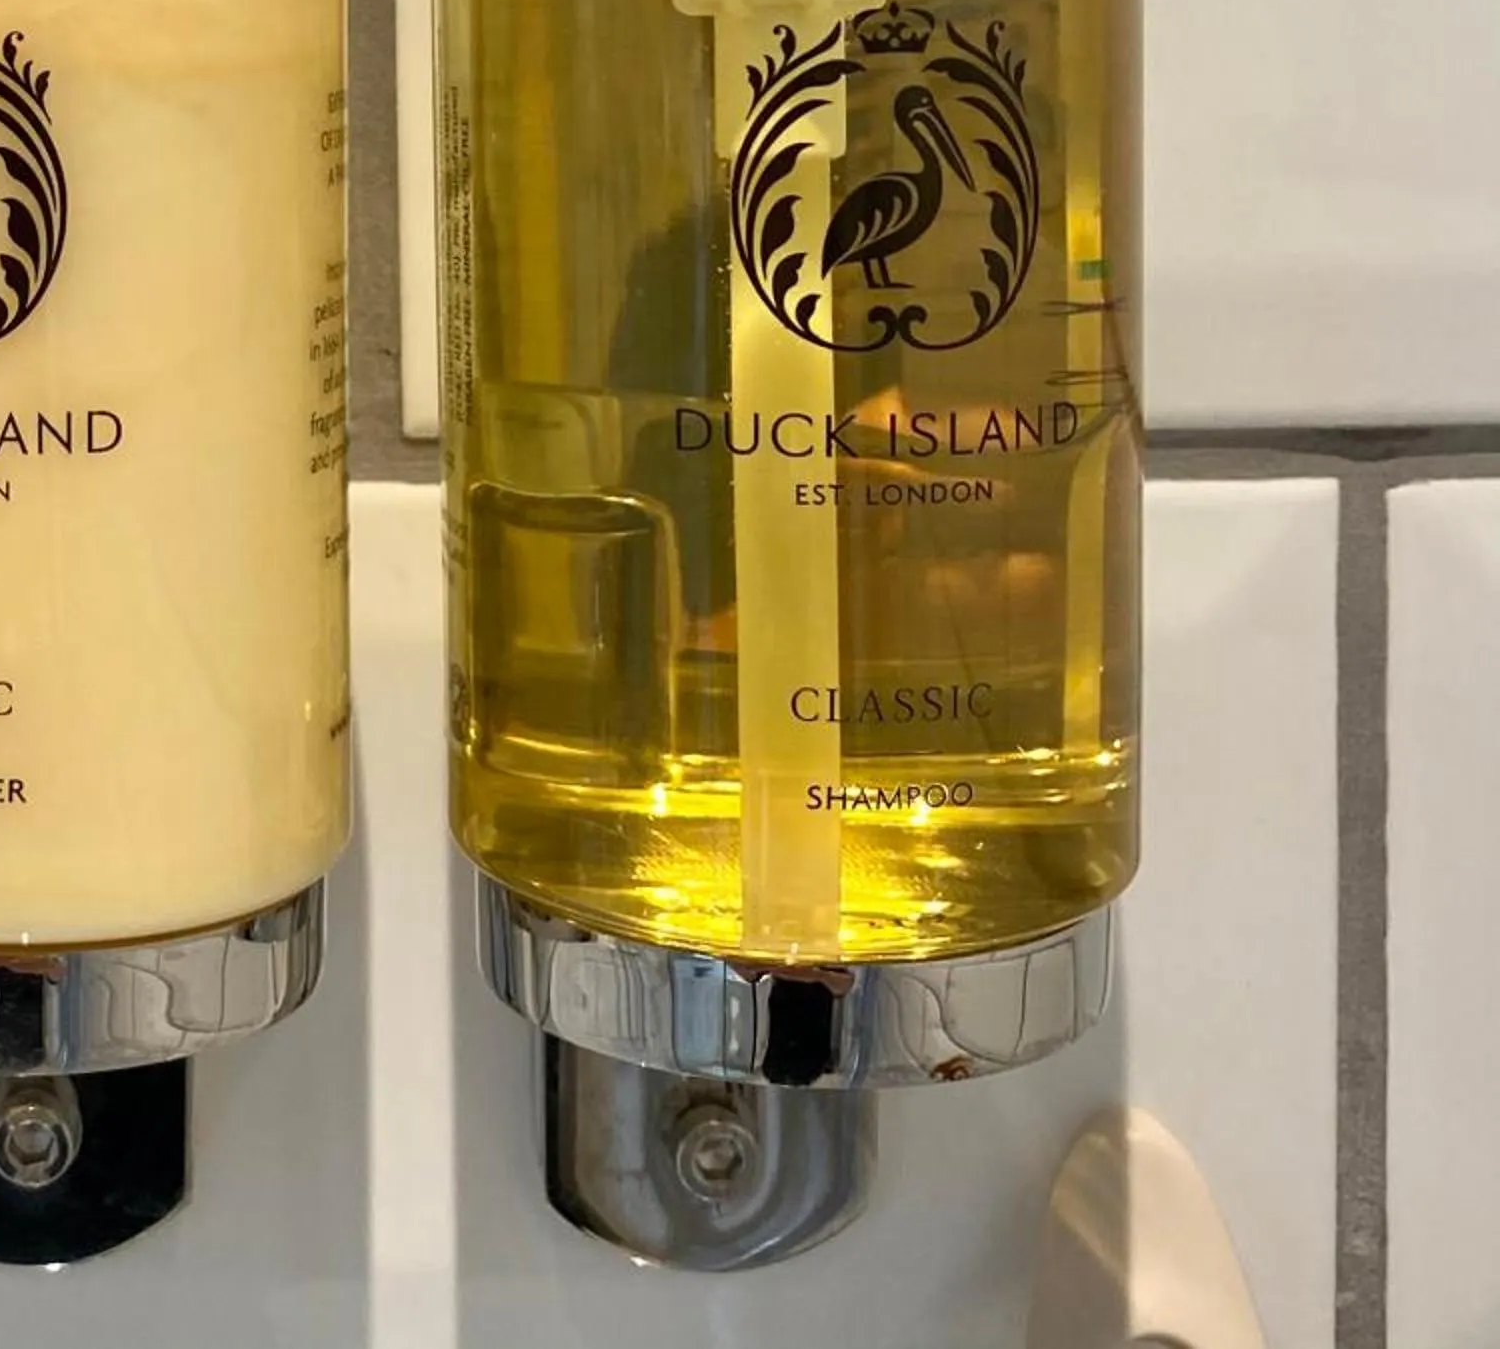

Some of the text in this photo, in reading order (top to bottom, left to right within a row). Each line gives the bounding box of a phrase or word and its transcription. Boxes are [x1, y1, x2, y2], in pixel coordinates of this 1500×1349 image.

[674, 400, 1080, 459] DUCK ISLAND
[866, 480, 994, 506] LONDON
[790, 681, 994, 725] CLASSIC
[805, 782, 974, 812] SHAMPOO
